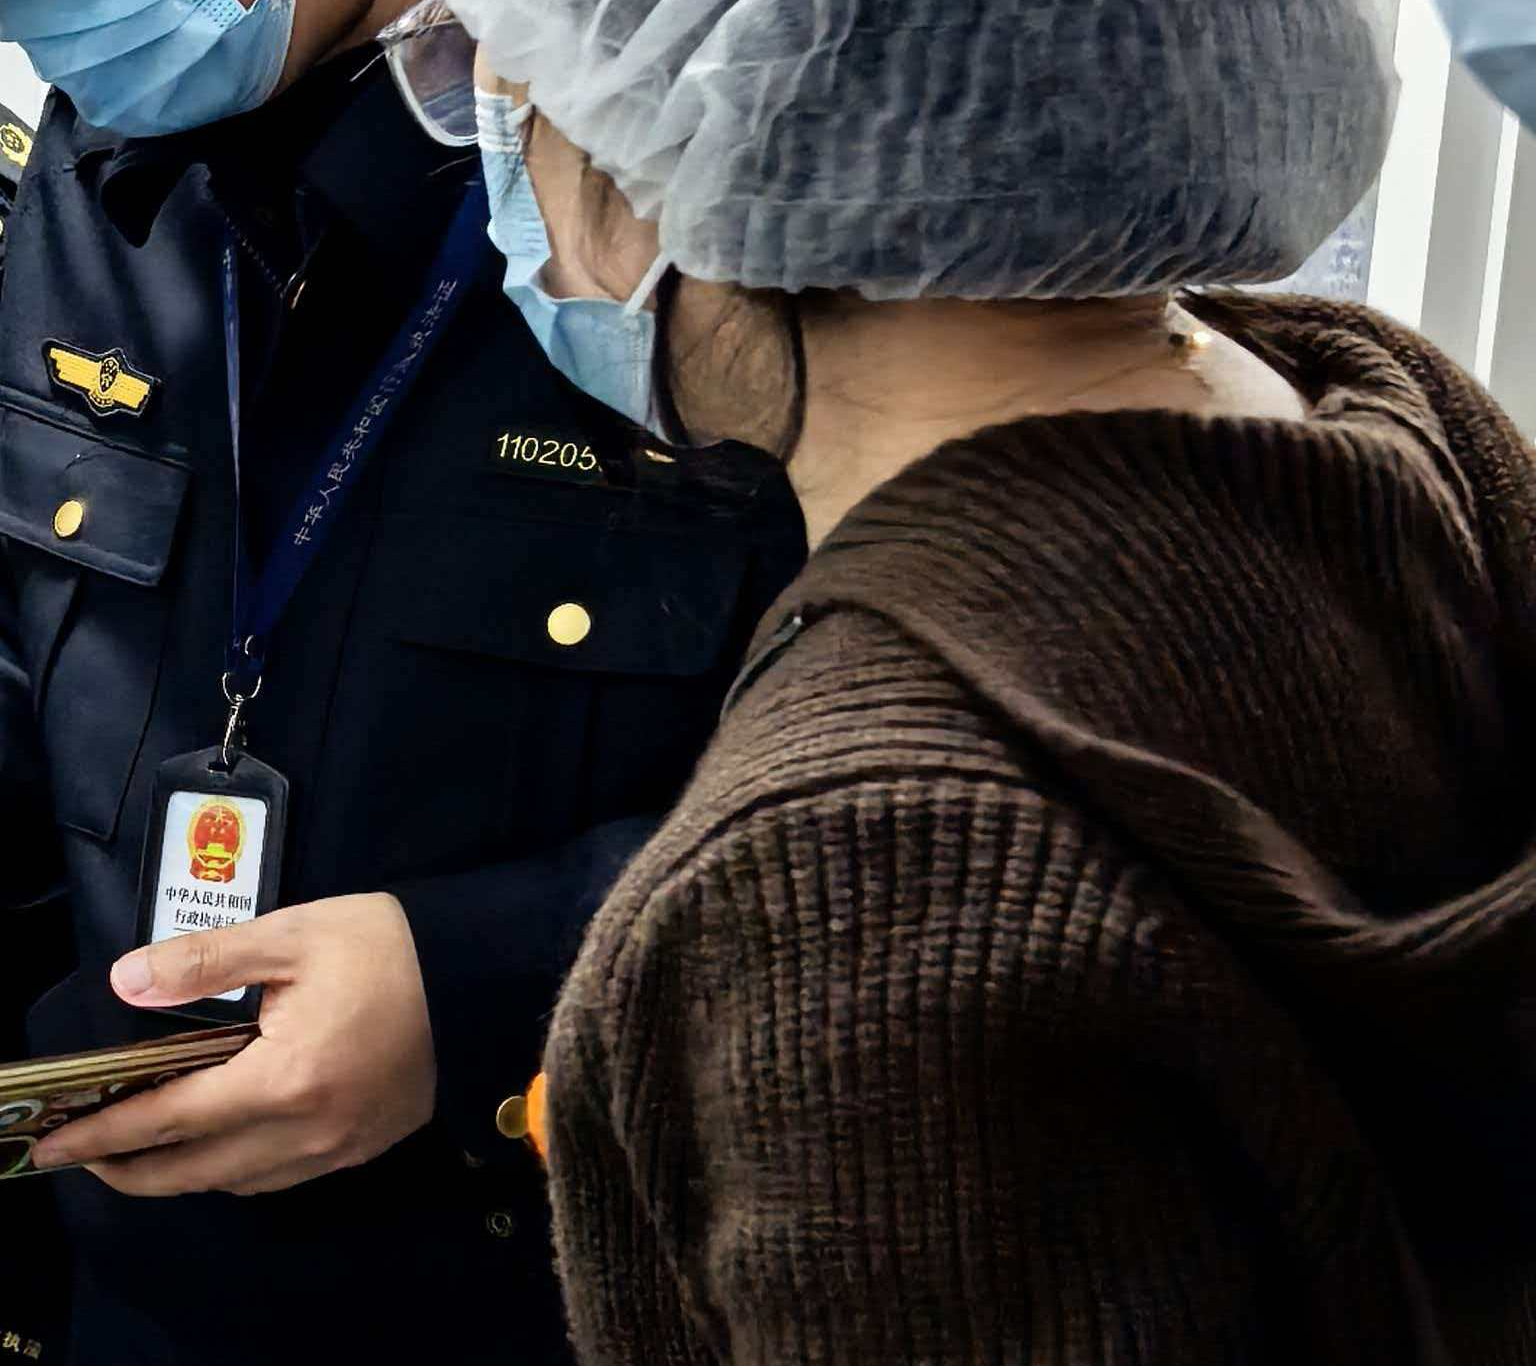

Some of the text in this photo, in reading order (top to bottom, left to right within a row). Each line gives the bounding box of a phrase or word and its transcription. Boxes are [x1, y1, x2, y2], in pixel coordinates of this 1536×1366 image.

[497, 432, 603, 474] 110205
[165, 885, 252, 912] 中华人民共和国
